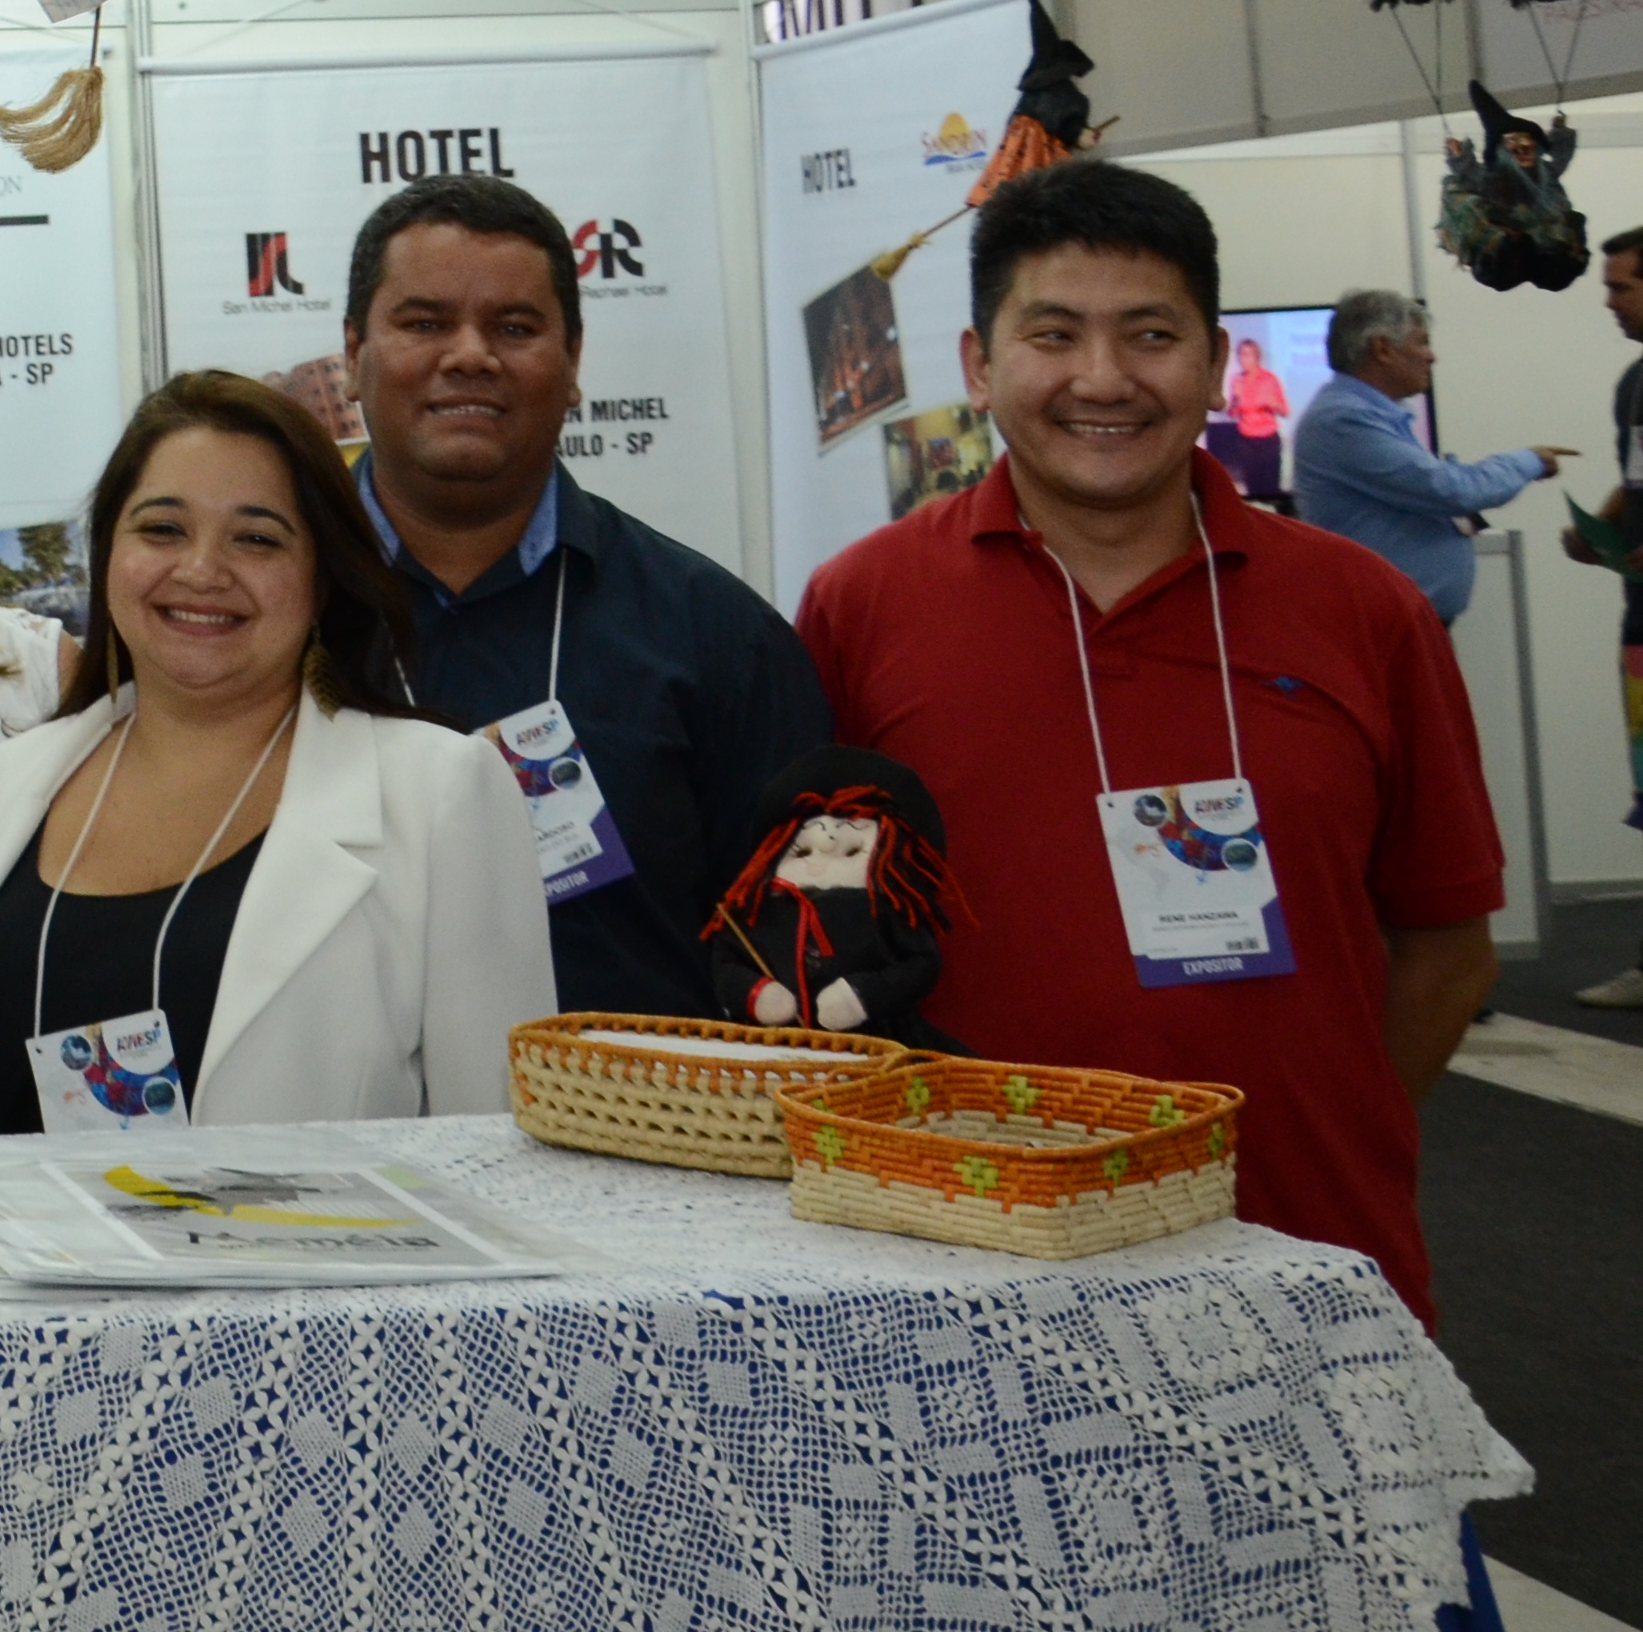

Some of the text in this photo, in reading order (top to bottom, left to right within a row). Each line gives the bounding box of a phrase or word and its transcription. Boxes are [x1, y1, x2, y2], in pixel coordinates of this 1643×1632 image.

[357, 126, 515, 184] HOTEL
[800, 146, 857, 195] HOTEL
[26, 363, 54, 386] SP
[591, 397, 669, 422] MICHEL
[627, 432, 653, 455] SP
